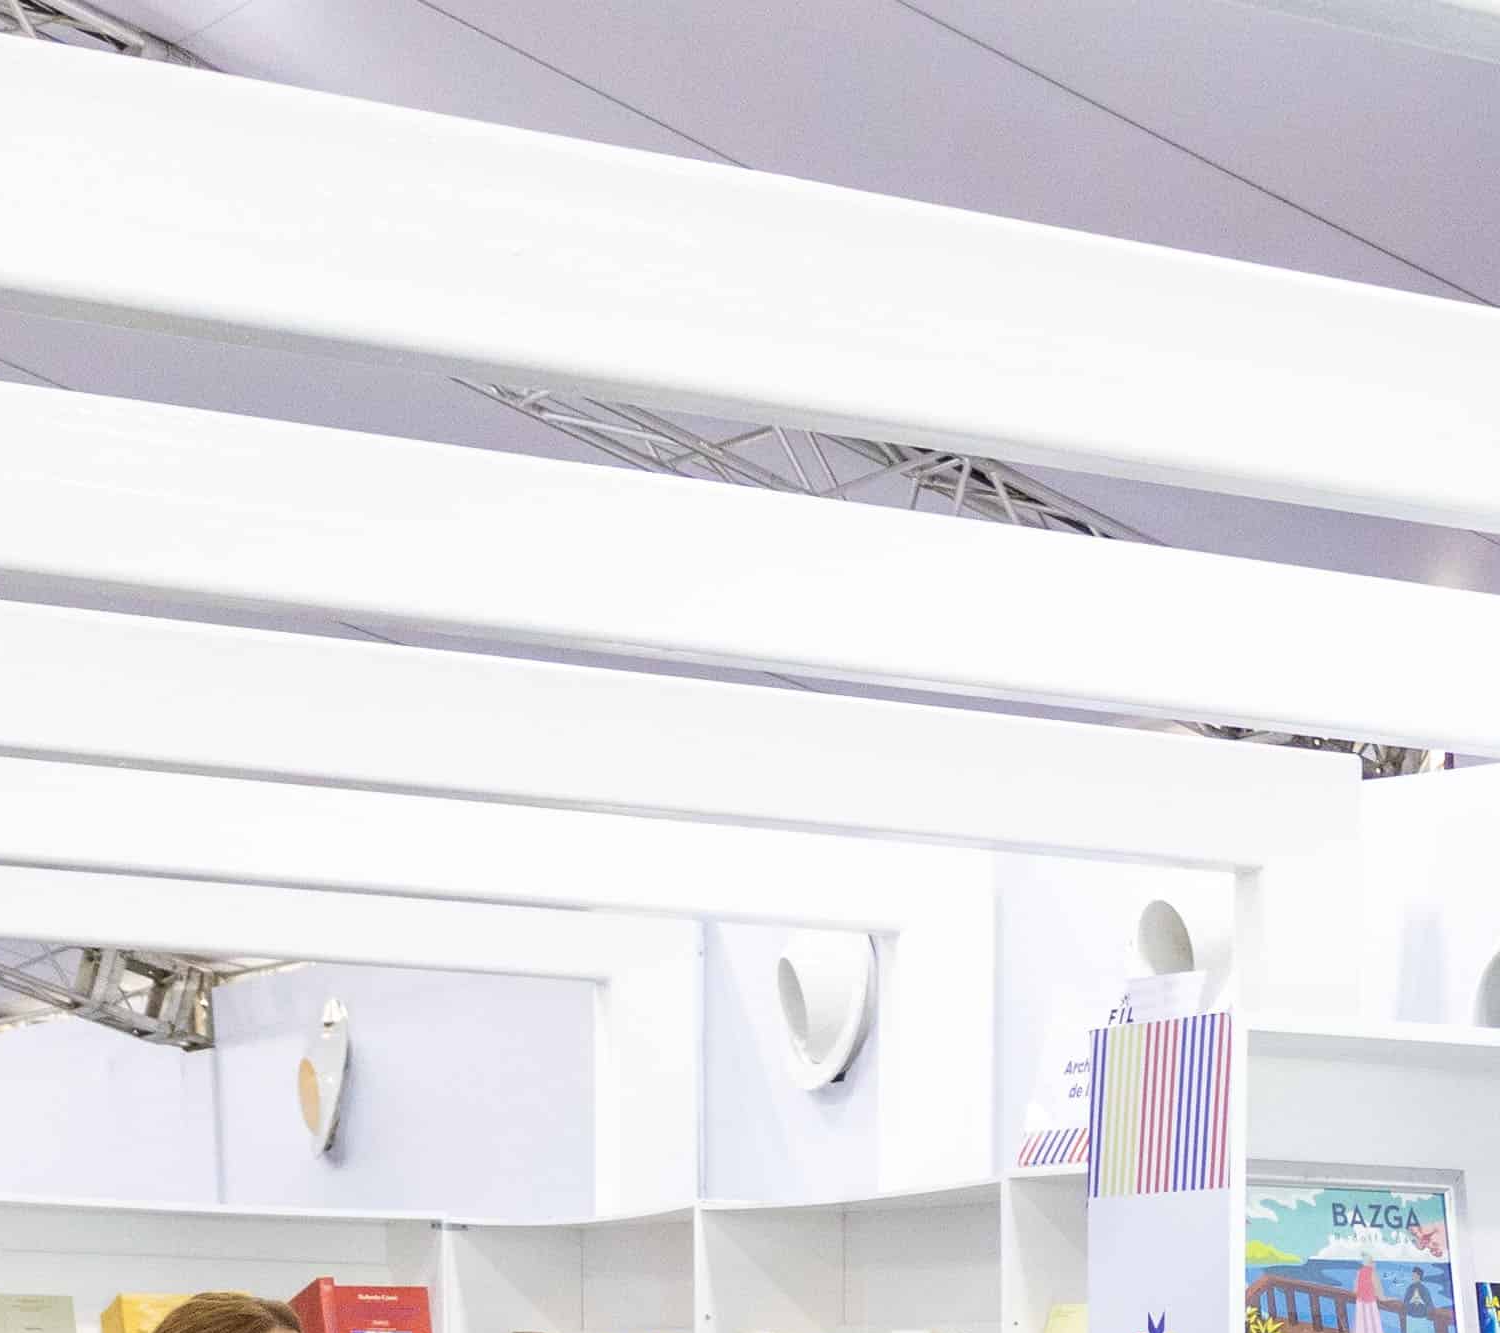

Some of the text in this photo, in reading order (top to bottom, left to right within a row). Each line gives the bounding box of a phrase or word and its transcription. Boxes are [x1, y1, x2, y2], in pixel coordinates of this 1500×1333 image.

[1108, 1006, 1134, 1025] FIL
[1063, 1057, 1090, 1075] Arch
[1331, 1202, 1421, 1230] BAZGA
[1485, 1295, 1500, 1308] LA
